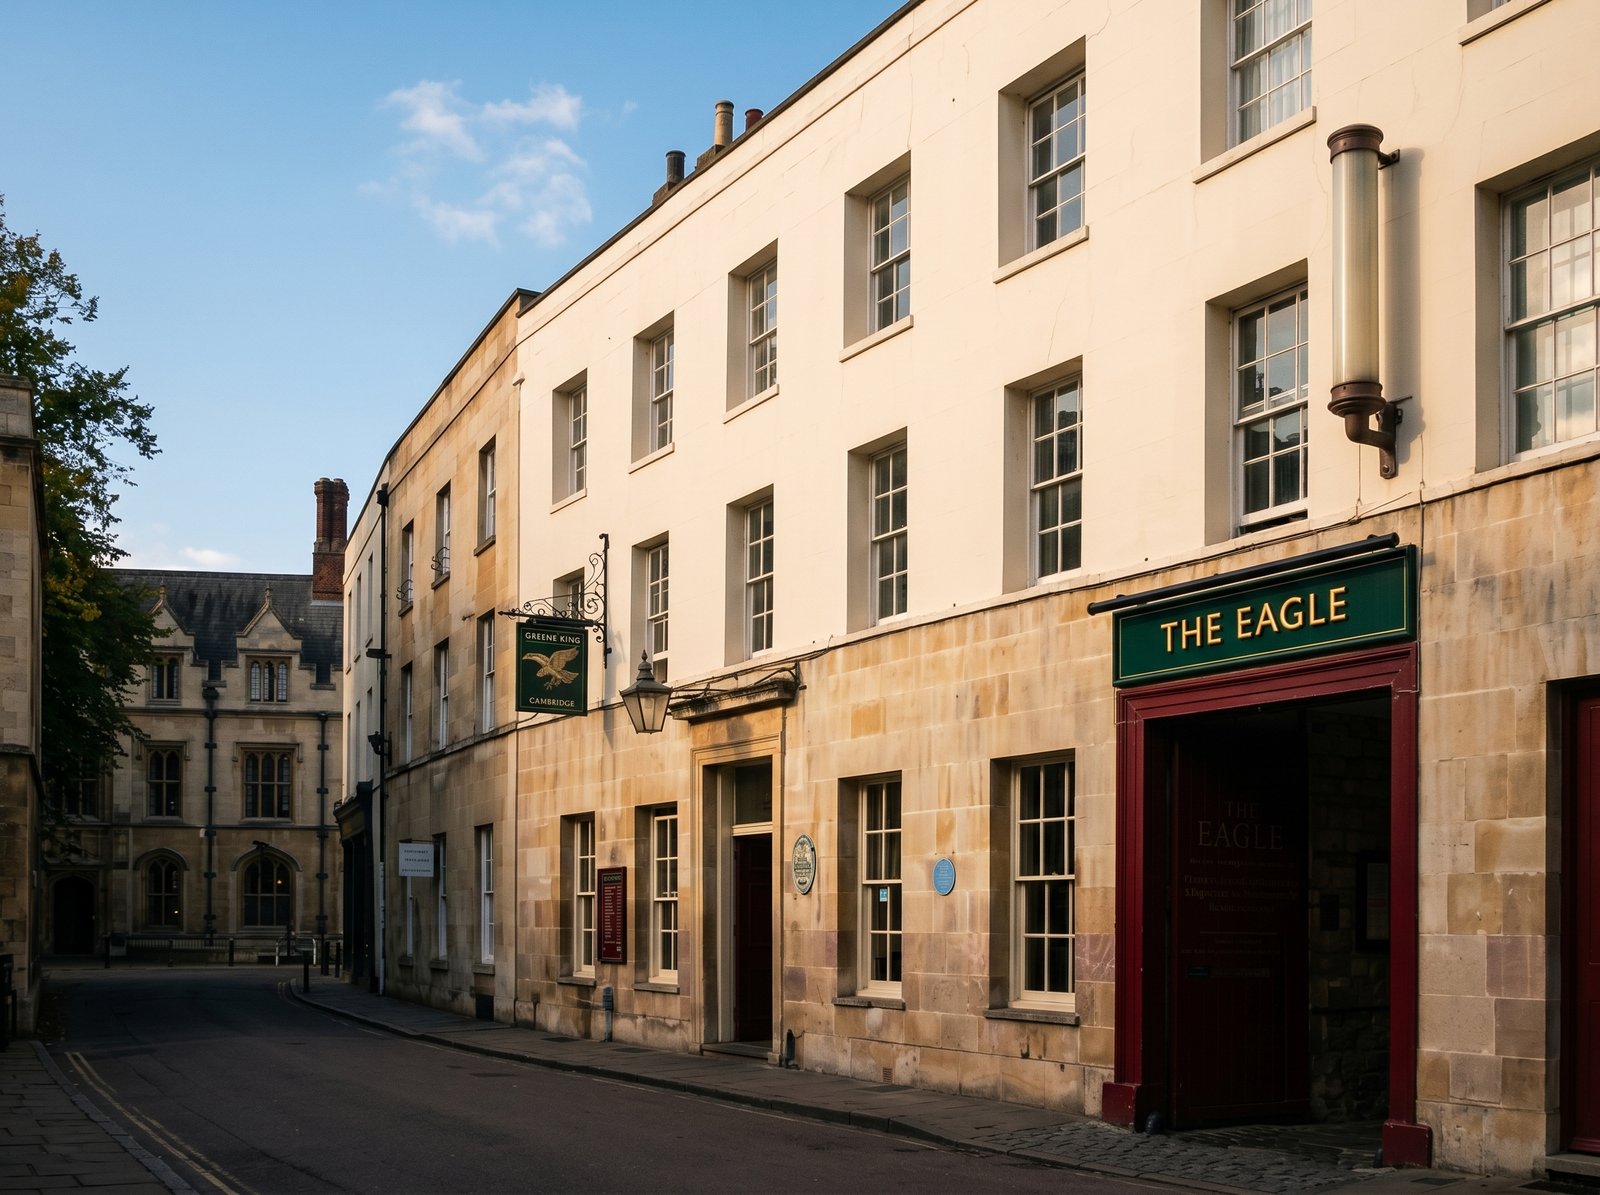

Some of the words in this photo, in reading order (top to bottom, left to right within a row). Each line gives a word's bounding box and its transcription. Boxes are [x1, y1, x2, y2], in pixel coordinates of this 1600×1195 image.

[1160, 612, 1222, 653] THE
[1236, 586, 1347, 639] EAGLE
[525, 631, 557, 642] GREENE
[560, 635, 581, 644] KING
[529, 697, 575, 707] CAMBRIDGE
[1223, 800, 1260, 819] THE
[1197, 820, 1284, 851] EAGLE
